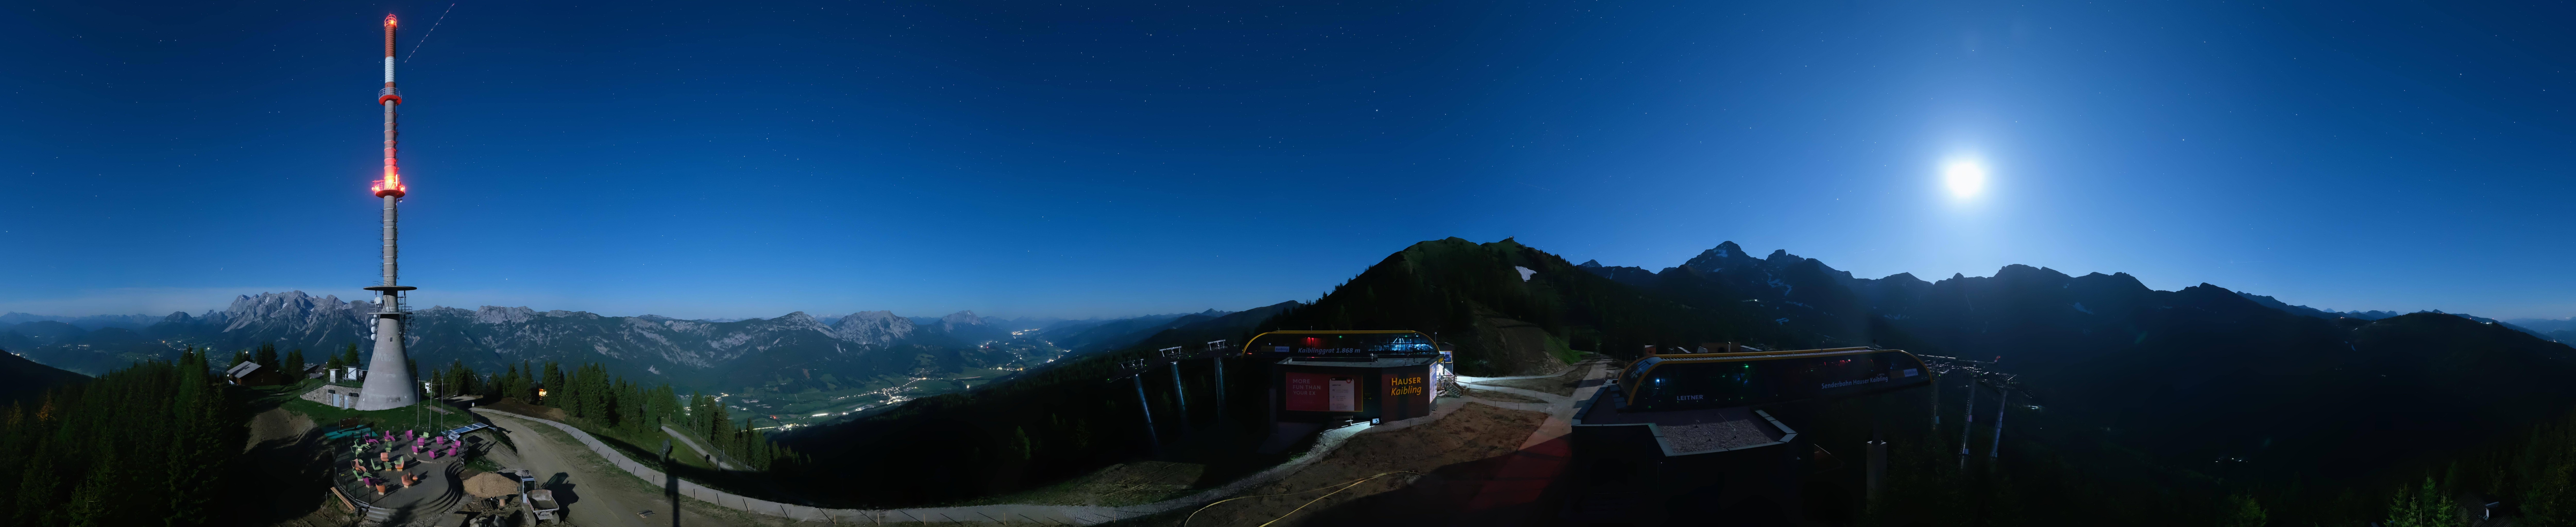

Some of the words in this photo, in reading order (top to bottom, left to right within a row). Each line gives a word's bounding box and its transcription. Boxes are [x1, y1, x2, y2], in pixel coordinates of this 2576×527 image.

[1391, 377, 1421, 386] HAUSER
[1821, 380, 1852, 389] Senderbahn
[1391, 386, 1422, 396] Kaibling
